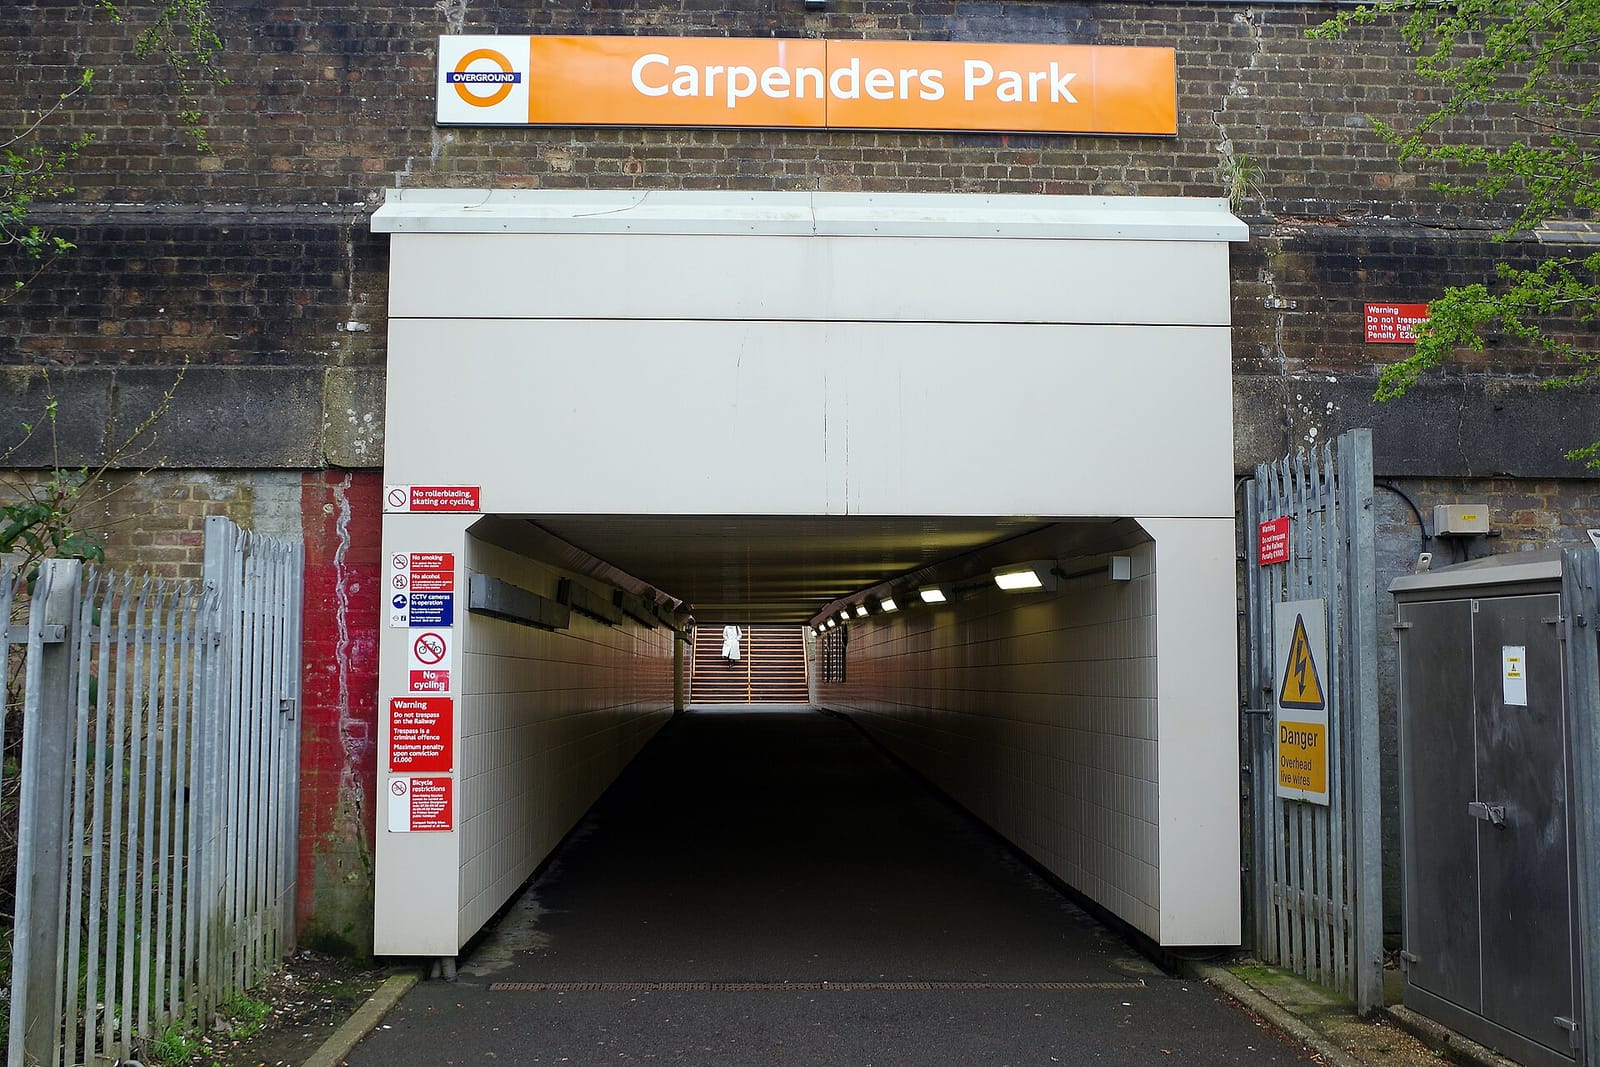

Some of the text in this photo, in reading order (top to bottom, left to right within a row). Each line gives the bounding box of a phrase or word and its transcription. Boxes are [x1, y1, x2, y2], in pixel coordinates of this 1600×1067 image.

[452, 73, 515, 83] OVERGROUND
[631, 53, 1078, 108] Carpenders Park
[1368, 305, 1399, 315] Warning
[1368, 331, 1396, 340] Penalty
[425, 489, 472, 499] rollerblading,
[412, 498, 439, 507] skating
[449, 498, 475, 507] cycling
[421, 554, 443, 562] smoking
[423, 671, 436, 679] No
[413, 681, 445, 691] cycling
[393, 700, 428, 710] Warning
[413, 718, 437, 726] Railway
[1280, 725, 1318, 750] Danger
[1280, 755, 1312, 771] Overhead
[1280, 770, 1311, 786] live wires
